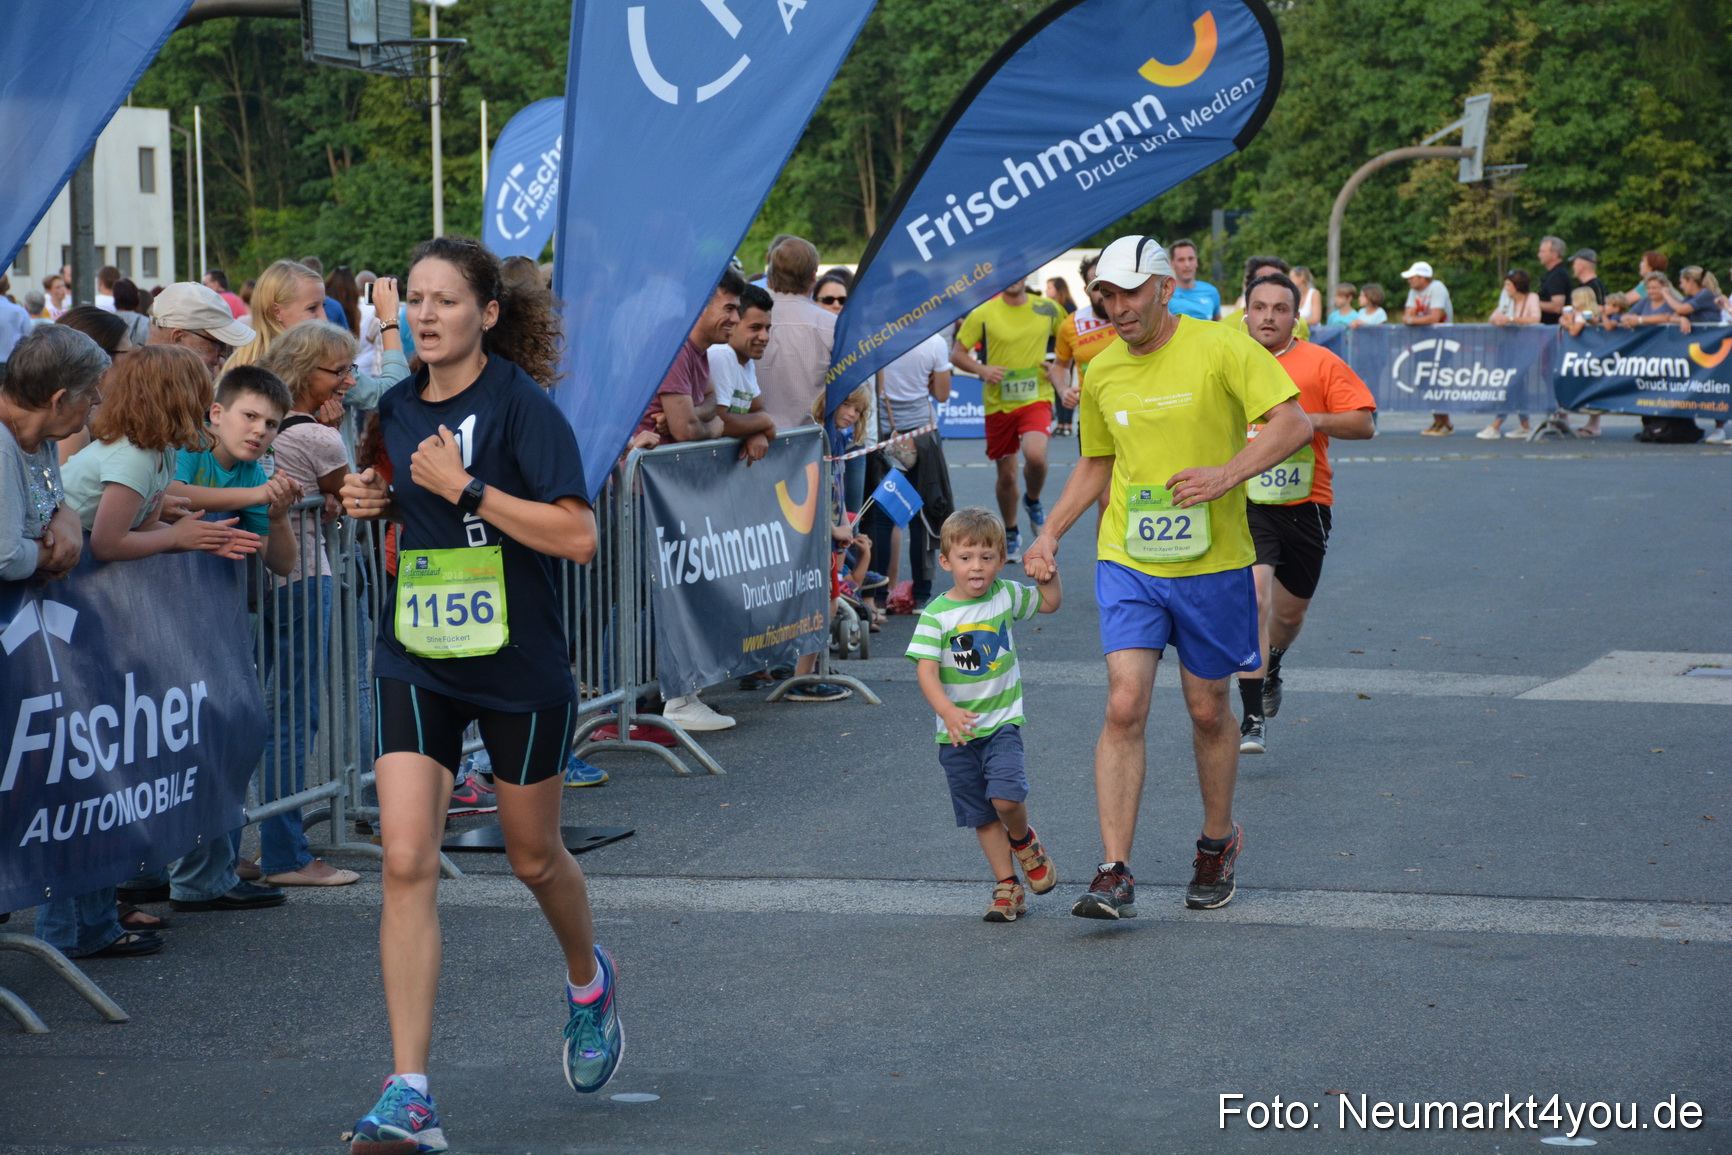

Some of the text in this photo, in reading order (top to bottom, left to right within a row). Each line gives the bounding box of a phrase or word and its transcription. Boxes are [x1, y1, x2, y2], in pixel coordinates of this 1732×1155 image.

[1075, 76, 1255, 191] Druck und Medien
[905, 93, 1168, 263] Frischmann
[825, 261, 995, 385] www.frischmann-net.de
[1414, 361, 1517, 387] Fischer
[1560, 351, 1690, 378] Frischmann
[1004, 380, 1036, 394] 1179
[1423, 389, 1506, 402] AUTOMOBILE
[1635, 377, 1731, 395] Druck und Medien
[1260, 467, 1301, 488] 584
[1138, 515, 1193, 542] 622
[656, 516, 790, 589] Frischmann
[742, 576, 773, 611] Druck
[772, 570, 794, 602] und
[406, 590, 495, 628] 1156
[442, 634, 471, 643] Fückert
[0, 672, 208, 792] Fischer
[18, 766, 198, 847] AUTOMOBILE
